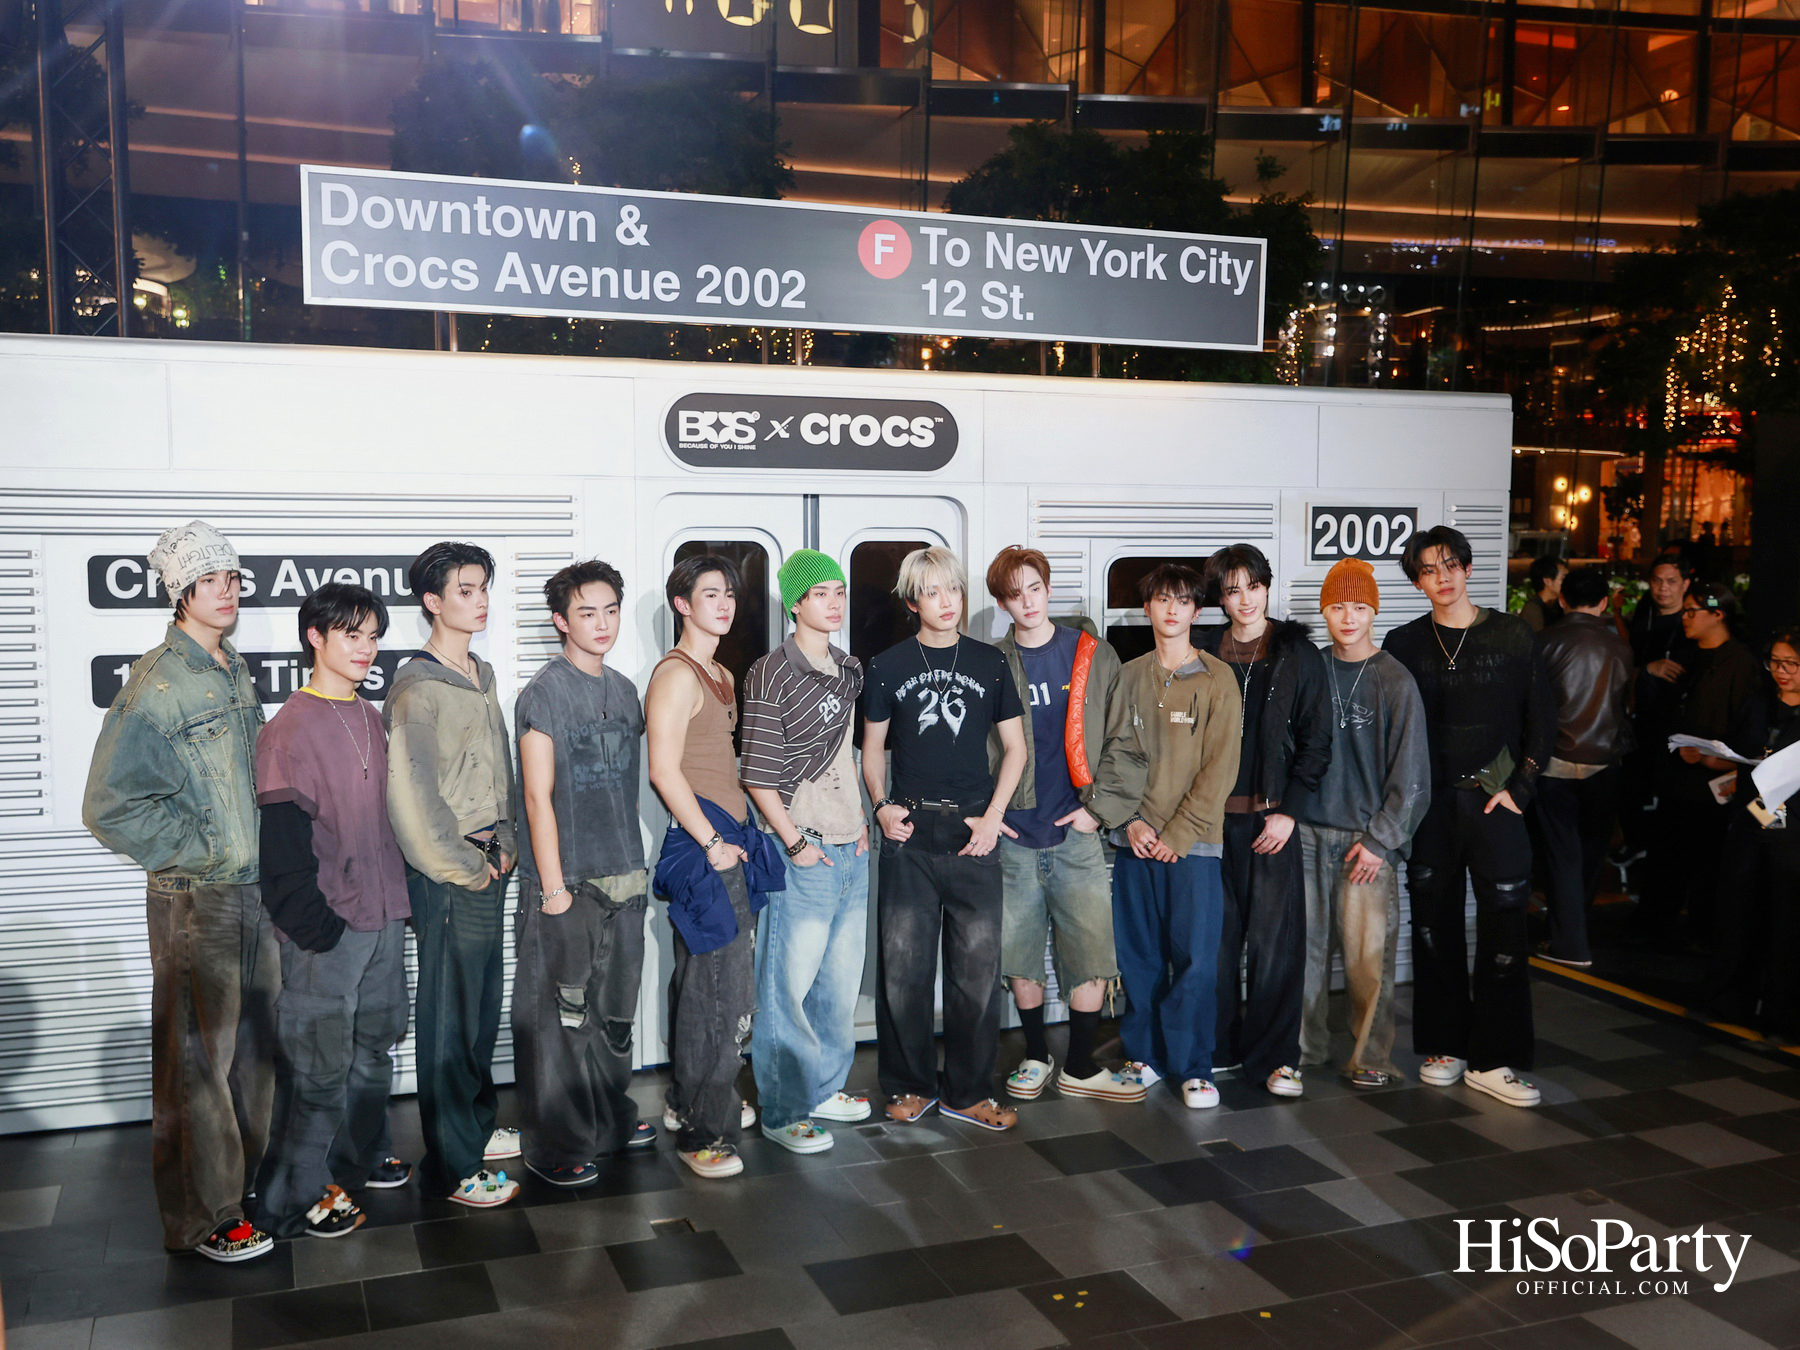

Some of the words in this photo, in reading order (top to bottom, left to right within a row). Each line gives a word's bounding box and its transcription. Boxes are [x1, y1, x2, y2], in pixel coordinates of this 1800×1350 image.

[320, 181, 597, 243] Downtown
[615, 204, 650, 247] &
[874, 233, 896, 265] F
[919, 226, 971, 268] To
[985, 232, 1073, 274] New
[1080, 238, 1168, 281] York
[1179, 245, 1254, 295] City
[320, 240, 480, 292] Crocs
[494, 252, 681, 303] Avenue
[695, 264, 807, 309] 2002
[921, 278, 967, 317] 12
[981, 281, 1035, 321] St.
[678, 442, 708, 450] BECAUSE
[1313, 513, 1415, 556] 2002
[818, 693, 841, 724] 26
[917, 685, 967, 737] 26
